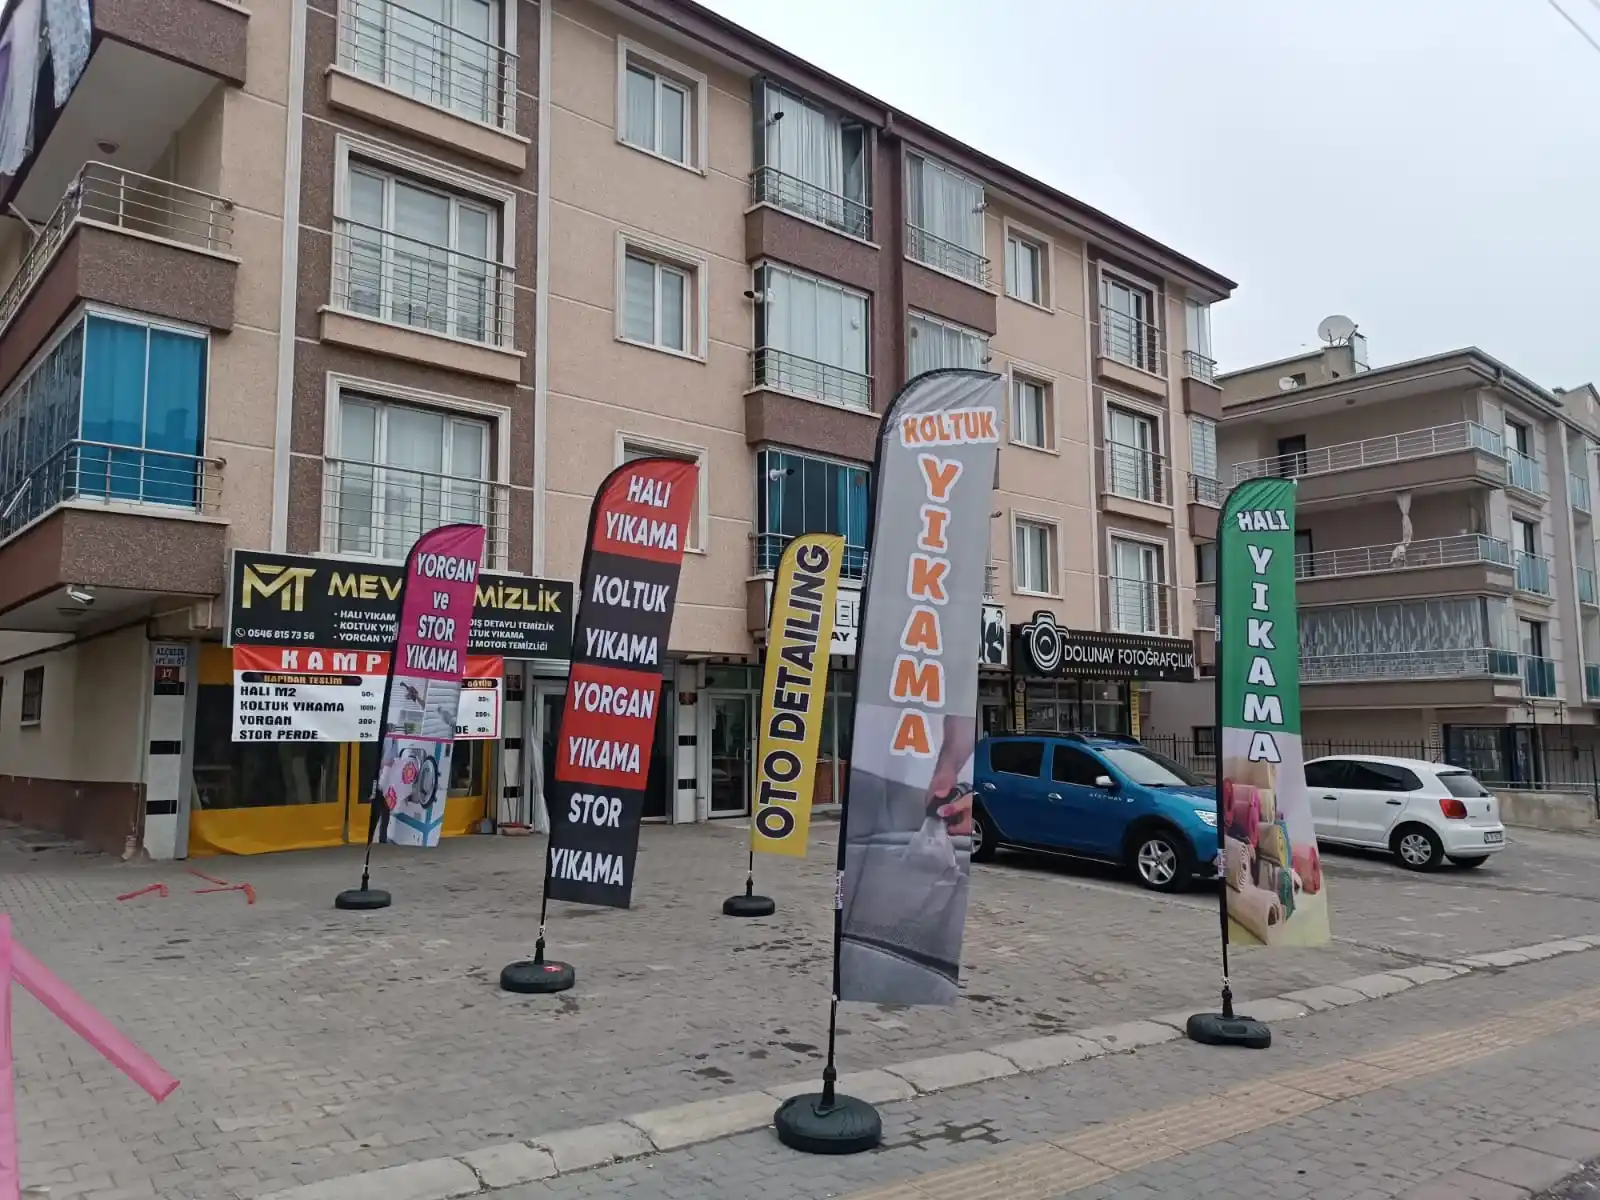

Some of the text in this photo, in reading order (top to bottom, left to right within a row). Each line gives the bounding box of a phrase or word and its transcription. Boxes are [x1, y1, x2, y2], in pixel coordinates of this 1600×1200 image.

[903, 409, 997, 444] KOLTUK
[627, 475, 672, 508] HALI
[606, 511, 678, 551] YIKAMA
[1237, 510, 1290, 532] HALI
[416, 552, 477, 582] YORGAN
[327, 571, 562, 612] MEV MİZLİK
[432, 591, 450, 610] ve
[592, 574, 671, 613] KOLTUK
[892, 456, 961, 755] YIKAMA
[339, 621, 396, 632] KOLTUK YIK
[340, 610, 396, 621] HALI YIKAM
[417, 614, 456, 641] STOR
[483, 619, 517, 629] DETAYLI
[518, 621, 555, 631] TEMİZLİK
[247, 628, 273, 638] 0546
[274, 630, 290, 639] 815
[339, 632, 381, 642] YORGAN
[469, 629, 525, 640] LTUK YIKAMA
[475, 639, 507, 649] MOTOR
[585, 627, 659, 665] YIKAMA
[281, 650, 382, 673] KAMP
[405, 644, 459, 674] YIKAMA
[1064, 643, 1195, 672] DOLUNAY FOTOĞRAFÇILIK
[1243, 546, 1284, 763] YIKAMA
[240, 685, 270, 696] HALI
[274, 686, 297, 698] M2
[240, 700, 289, 712] KOLTUK
[292, 701, 345, 712] YIKAMA
[573, 680, 656, 720] YORGAN
[756, 543, 830, 840] OTO DETAILING
[239, 714, 292, 726] YORGAN
[239, 729, 272, 740] STOR
[276, 729, 319, 740] PERDE
[567, 735, 641, 774] YIKAMA
[567, 792, 623, 828] STOR
[550, 847, 624, 887] YIKAMA
